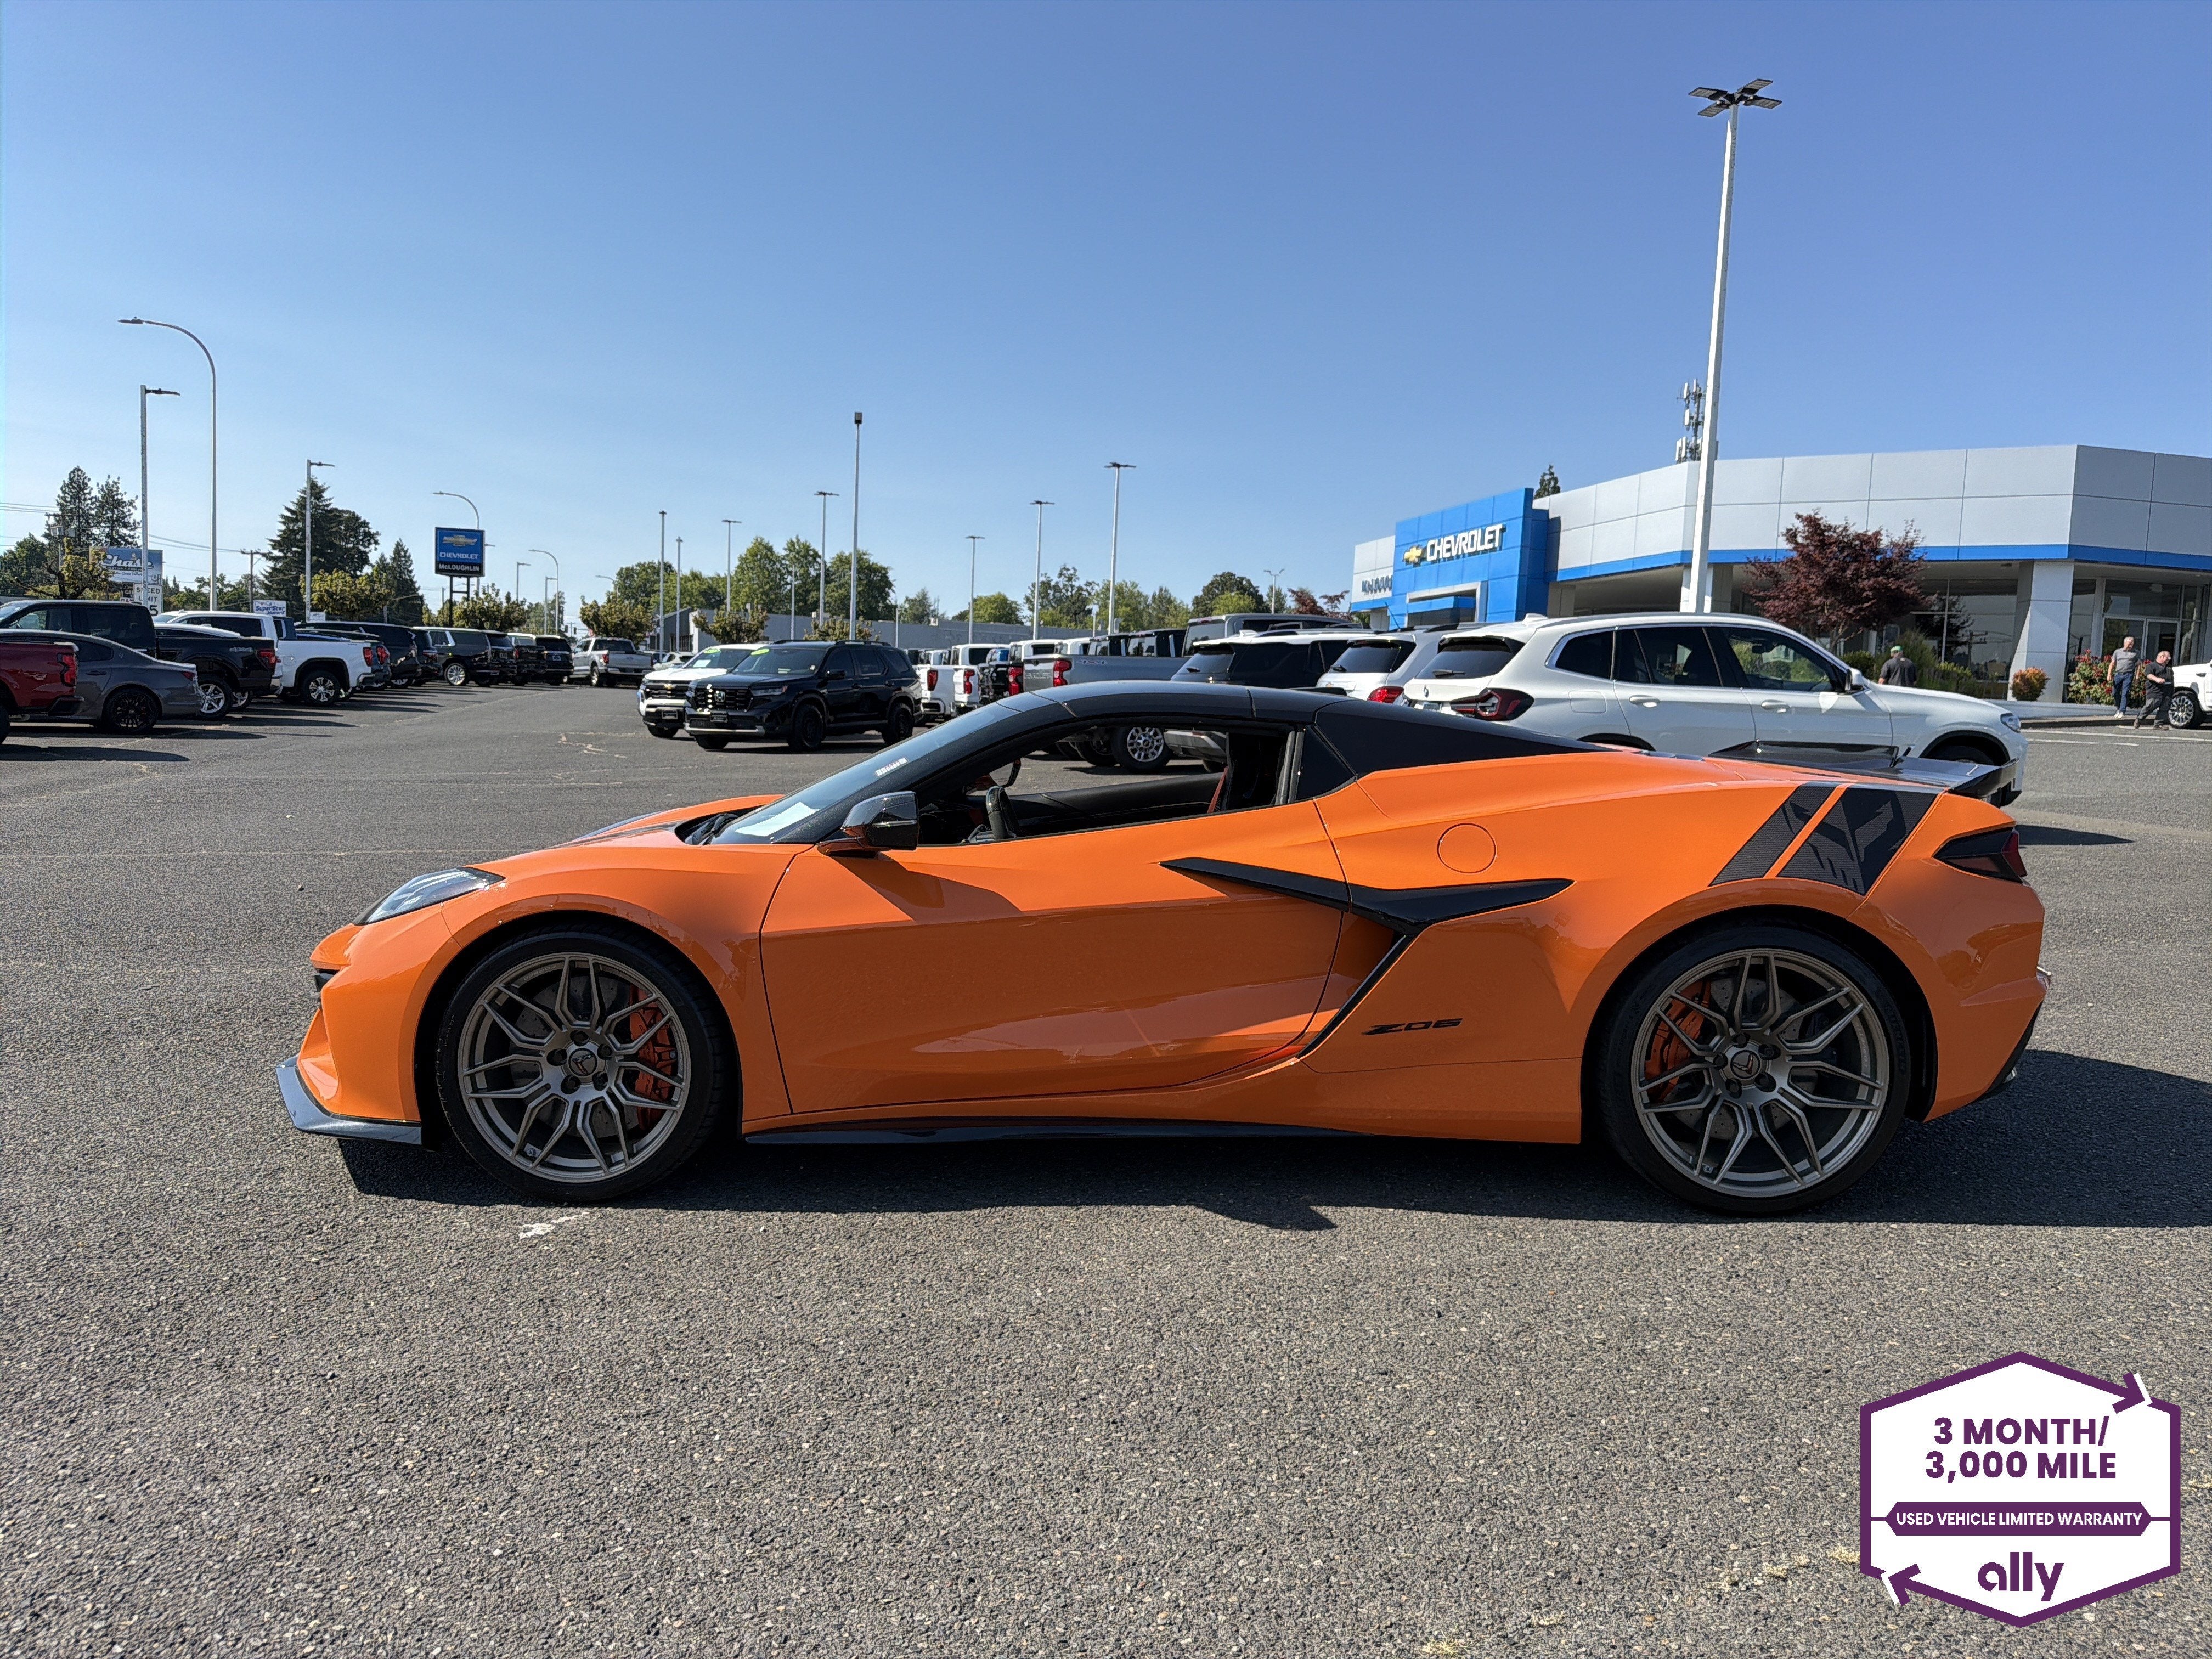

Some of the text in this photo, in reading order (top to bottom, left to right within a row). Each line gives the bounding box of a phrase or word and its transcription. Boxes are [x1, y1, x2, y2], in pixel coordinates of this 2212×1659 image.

[1426, 523, 1504, 561] CHEVROLET
[439, 551, 478, 560] CHEVROLET
[1362, 1018, 1463, 1035] Z06
